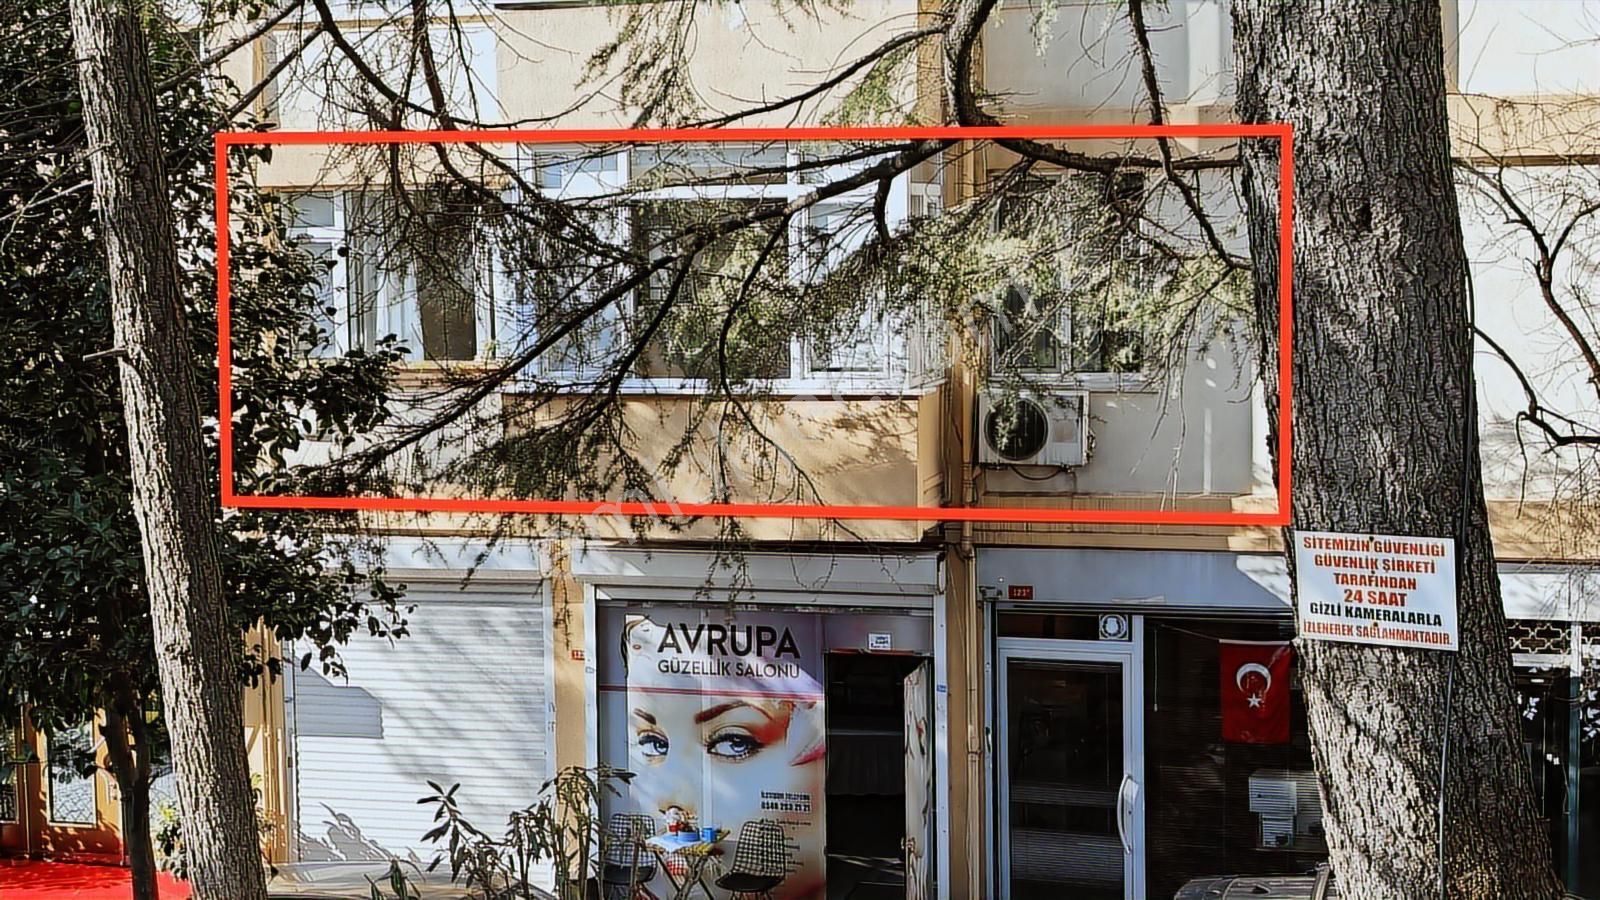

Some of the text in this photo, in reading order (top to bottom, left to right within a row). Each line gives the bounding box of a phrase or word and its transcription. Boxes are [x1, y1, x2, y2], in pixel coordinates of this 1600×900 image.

[1303, 536, 1370, 551] SİTEMİZİN
[1314, 553, 1436, 573] GÜVENLİK ŞİRKETİ
[1333, 573, 1417, 590] TARAFINDAN
[1344, 589, 1407, 607] 24 SAAT
[1310, 602, 1442, 627] GİZLİ KAMERALARLA
[1303, 620, 1354, 636] İZLENEREK
[657, 622, 801, 659] AVRUPA
[658, 657, 801, 679] GÜZELLİK SALONU
